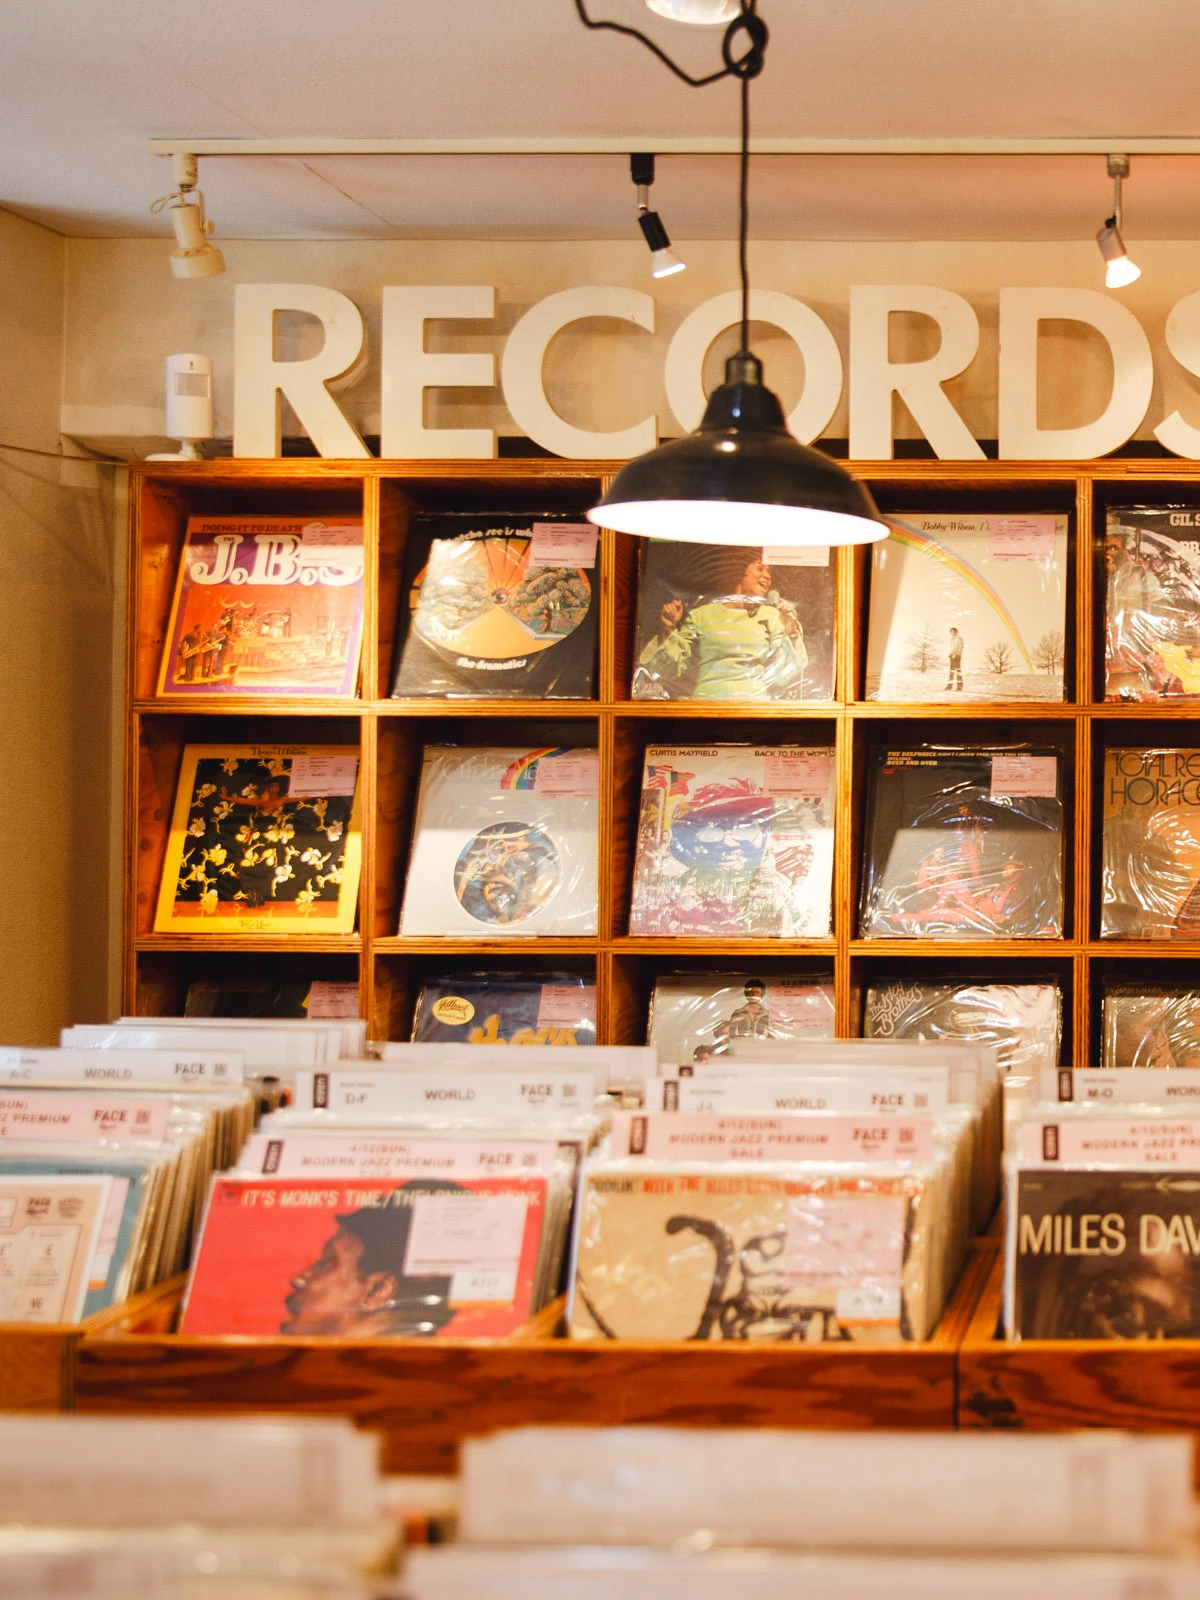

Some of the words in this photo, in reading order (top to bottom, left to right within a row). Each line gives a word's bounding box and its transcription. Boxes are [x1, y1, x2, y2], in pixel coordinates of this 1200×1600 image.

[1170, 514, 1194, 526] GIL
[920, 521, 948, 533] Bobby
[650, 749, 677, 757] CURTIS
[679, 749, 719, 757] MAYFIELD
[85, 1068, 133, 1080] WORLD
[175, 1062, 206, 1075] FACE
[425, 1088, 476, 1101] WORLD
[521, 1084, 554, 1096] FACE
[776, 1097, 827, 1110] WORLD
[872, 1094, 905, 1107] FACE
[14, 1113, 71, 1124] PREMIUM
[93, 1110, 128, 1122] FACE
[853, 1127, 889, 1141] FACE
[478, 1152, 513, 1166] FACE
[243, 1189, 276, 1207] IT'S
[280, 1189, 338, 1207] MONK'S
[1019, 1213, 1127, 1257] MILES
